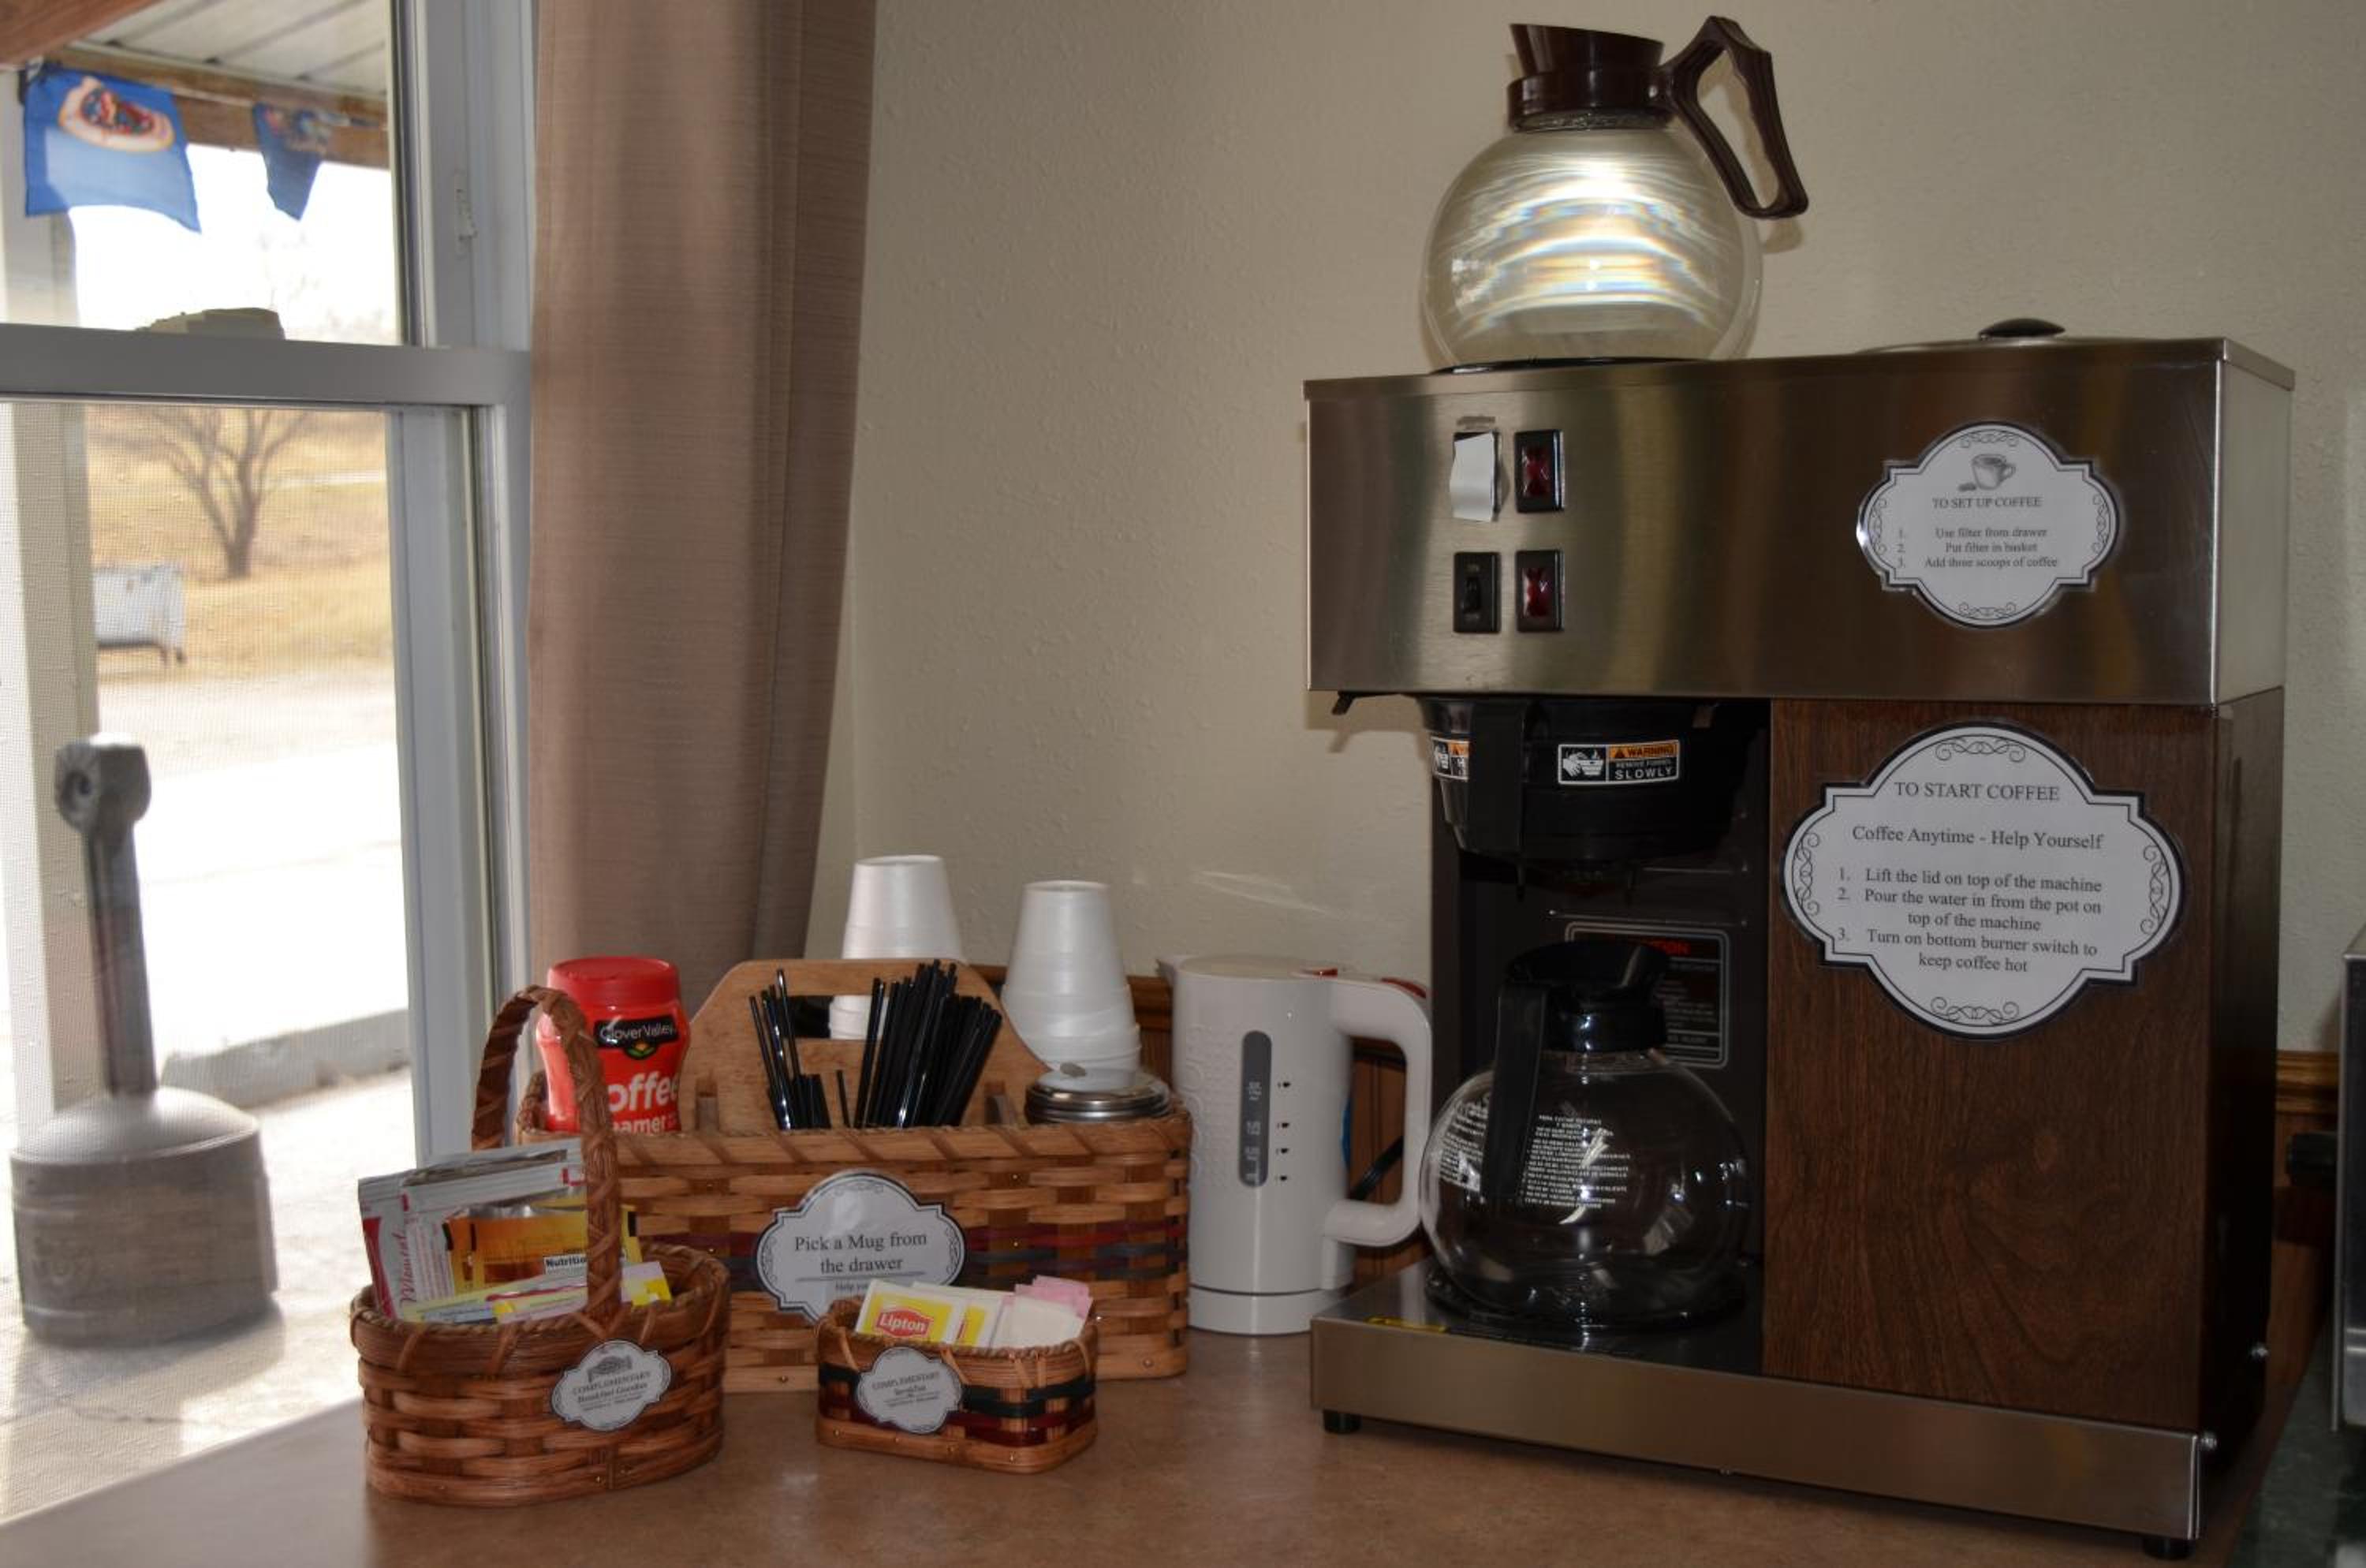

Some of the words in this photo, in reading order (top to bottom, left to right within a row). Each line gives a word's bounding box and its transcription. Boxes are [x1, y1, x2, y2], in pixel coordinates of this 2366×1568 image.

[1933, 498, 1948, 509] TO
[1950, 498, 1972, 509] SET
[1976, 497, 1993, 508] UP
[1995, 496, 2043, 508] COFFEE
[1935, 528, 1954, 538] Use
[1958, 527, 1982, 537] filter
[1985, 527, 2009, 537] from
[2012, 526, 2047, 537] drawer
[1946, 542, 1962, 553] Put
[1965, 542, 1989, 552] filter
[1992, 542, 2002, 552] in
[2004, 542, 2038, 552] basket
[1925, 557, 1946, 568] Add
[1948, 556, 1973, 568] three
[1976, 558, 2011, 569] scoops
[2013, 556, 2025, 568] of
[2026, 556, 2058, 568] coffee
[1628, 745, 1674, 757] WARNING
[1614, 767, 1673, 780] SLOWLY
[1894, 782, 1919, 797] TO
[1924, 782, 1982, 799] START
[1987, 784, 2060, 801] COFFEE
[1853, 825, 1904, 842] Coffee
[1906, 827, 1975, 846] Anytime
[1991, 830, 2028, 850] Help
[2033, 831, 2105, 849] Yourself
[1839, 867, 1850, 882] 1.
[1865, 868, 1890, 882] Lift
[1896, 870, 1917, 883] the
[1922, 871, 1940, 884] lid
[1945, 875, 1962, 885] on
[1968, 874, 1990, 890] top
[1994, 873, 2012, 888] of
[2015, 875, 2036, 889] the
[2039, 876, 2102, 893] machine
[1838, 887, 1850, 901] 2.
[1865, 889, 1897, 903] Pour
[1902, 890, 1923, 905] the
[1928, 894, 1968, 906] water
[1972, 894, 1985, 907] in
[1991, 894, 2025, 909] from
[2029, 896, 2051, 911] the
[2055, 899, 2079, 915] pot
[2083, 902, 2101, 914] on
[1908, 913, 1930, 928] top
[1934, 913, 1952, 927] of
[1954, 913, 1975, 928] the
[1980, 916, 2041, 931] machine
[1838, 928, 1850, 942] 3.
[1868, 928, 1900, 945] Turn
[1905, 935, 1922, 946] on
[1927, 933, 1976, 948] bottom
[1981, 937, 2027, 952] burner
[2032, 939, 2078, 955] switch
[2083, 943, 2097, 956] to
[1918, 952, 1952, 970] keep
[1956, 954, 2001, 971] coffee
[2005, 958, 2028, 972] hot
[600, 1026, 641, 1040] Clover
[608, 1071, 678, 1112] offe
[612, 1114, 666, 1133] amer
[795, 1234, 829, 1252] Pick
[834, 1240, 842, 1250] a
[849, 1234, 884, 1252] Mug
[890, 1232, 927, 1247] from
[546, 1256, 588, 1267] Nutritio
[820, 1258, 843, 1274] the
[849, 1256, 903, 1272] drawer
[879, 1312, 926, 1332] Lipton
